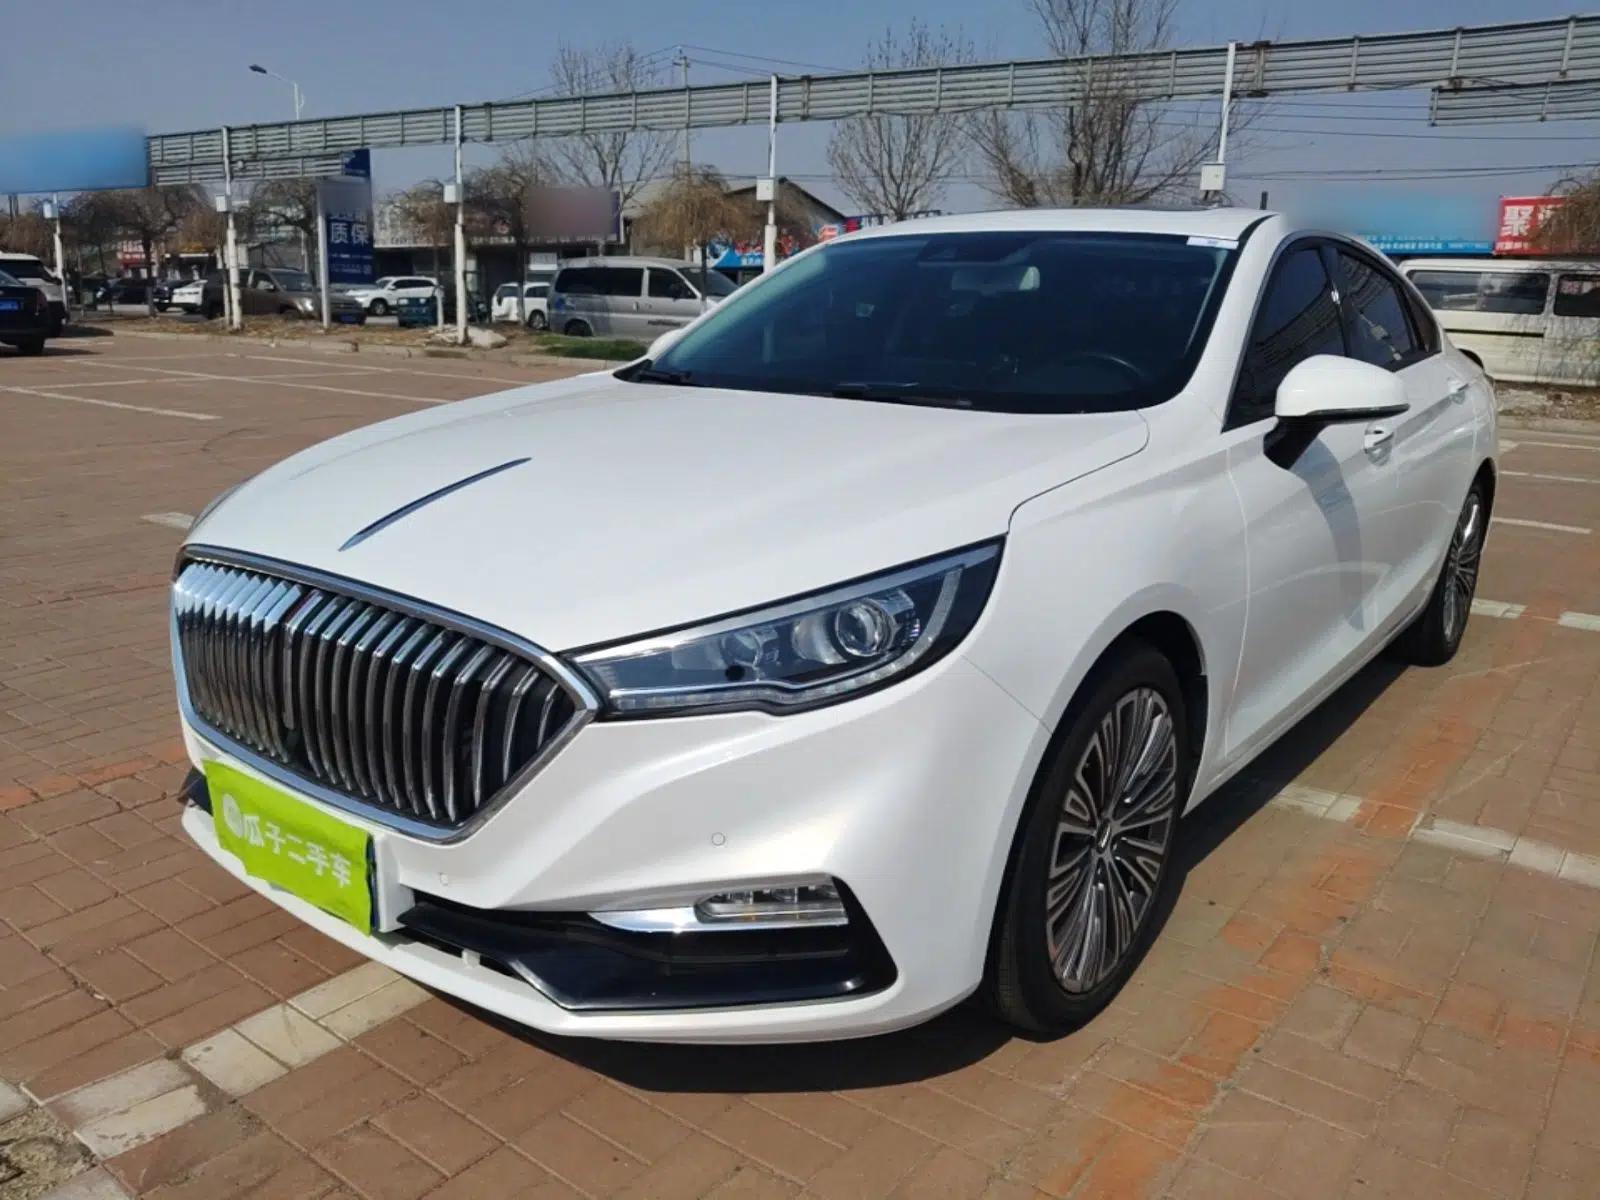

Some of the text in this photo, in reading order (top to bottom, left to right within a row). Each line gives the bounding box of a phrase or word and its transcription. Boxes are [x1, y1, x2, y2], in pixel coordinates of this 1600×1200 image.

[331, 222, 369, 247] 质保
[243, 815, 351, 887] 瓜子二手车
